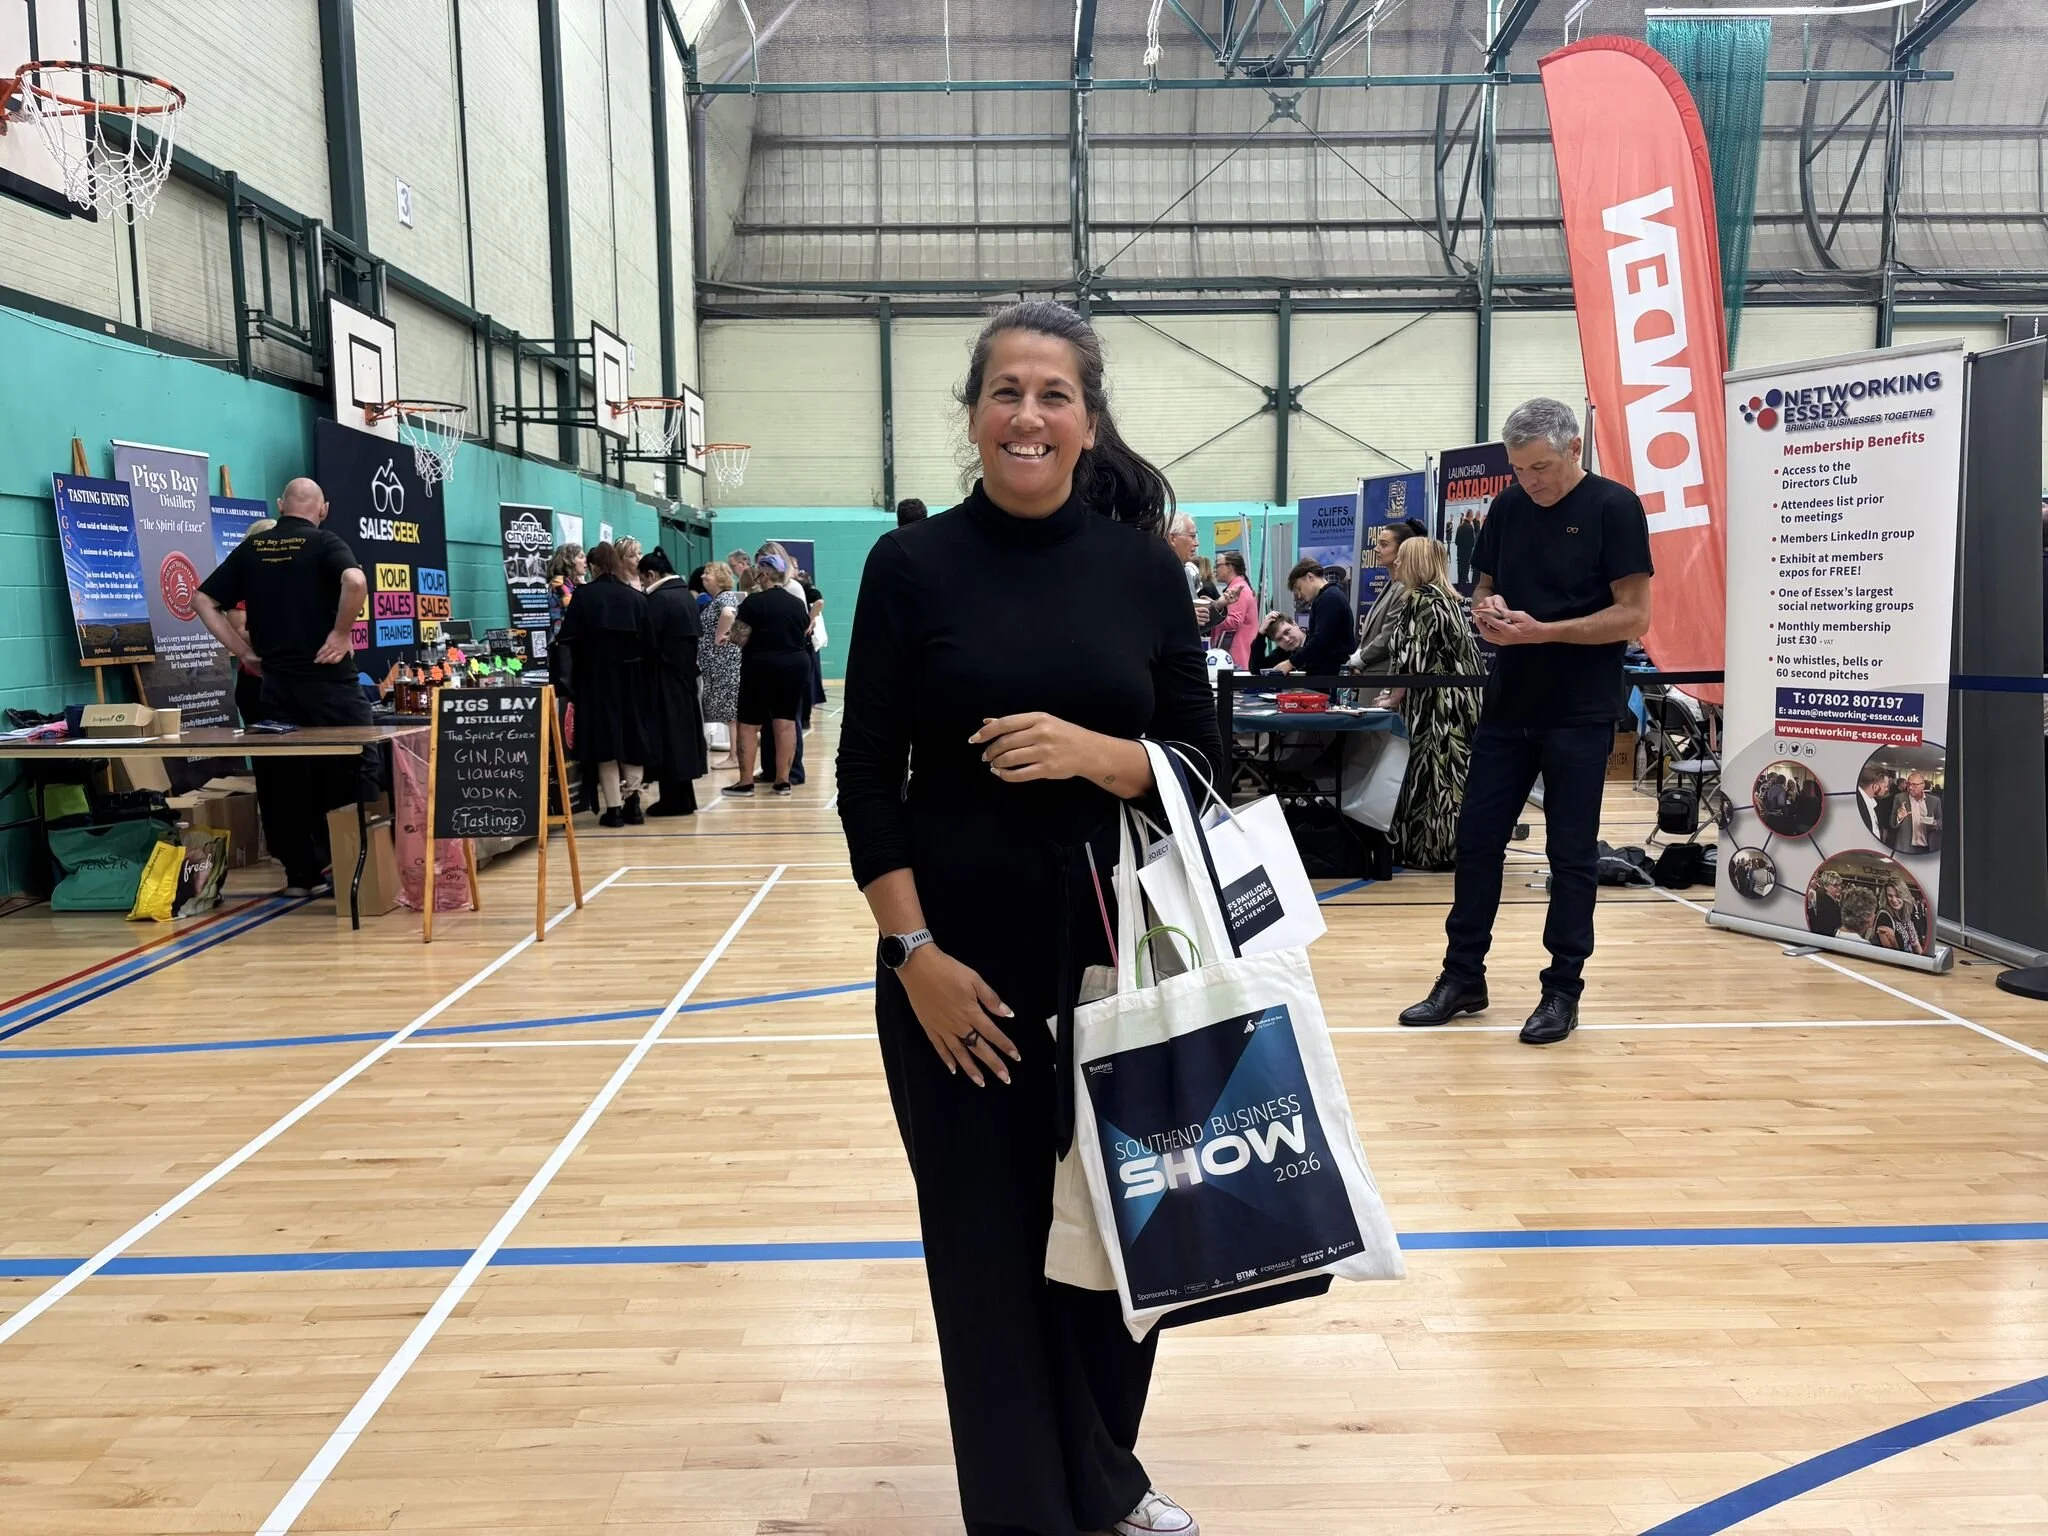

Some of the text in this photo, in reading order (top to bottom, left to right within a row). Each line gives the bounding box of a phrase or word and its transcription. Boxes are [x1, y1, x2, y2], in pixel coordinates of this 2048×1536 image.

[401, 188, 409, 217] 3
[1784, 371, 1941, 407] NETWORKING
[1784, 401, 1848, 424] ESSEX
[1785, 408, 1933, 432] BRINGING BUSINESSES TOGETHER
[1783, 432, 1925, 456] Membership Benefits
[1448, 464, 1486, 479] LAUNCHPAD
[1782, 461, 1851, 476] Access to the
[131, 464, 199, 497] Pigs Bay
[1782, 474, 1858, 490] Directors Club
[68, 488, 130, 507] TASTING EVENTS
[160, 494, 196, 512] Distillery
[1781, 494, 1885, 510] Attendees list prior
[1318, 506, 1349, 517] CLIFFS
[1781, 512, 1843, 524] to meetings
[156, 520, 176, 533] Spirit
[177, 520, 184, 534] of
[360, 516, 420, 544] SALESGEEK
[512, 522, 544, 533] DIGITAL
[1312, 516, 1354, 528] PAVILION
[506, 531, 552, 543] CITY RADIO
[1780, 529, 1915, 544] Members LinkedIn group
[1779, 551, 1884, 564] Exhibit at members
[380, 568, 407, 588] YOUR
[1779, 566, 1861, 579] expos for FREE!
[421, 572, 445, 592] YOUR
[1778, 586, 1893, 599] One of Essex's largest
[378, 595, 411, 617] SALES
[421, 597, 449, 618] SALES
[1778, 600, 1914, 613] social networking groups
[380, 625, 412, 641] TRAINER
[1777, 621, 1891, 634] Monthly membership
[1776, 635, 1796, 646] just
[1799, 635, 1817, 645] £30
[1777, 655, 1883, 667] No whistles, bells or
[1776, 669, 1869, 682] 60 second pitches
[443, 697, 537, 713] PIGS BAY
[1793, 692, 1903, 710] T: 07802 807197
[456, 714, 524, 725] DISTILLERY
[1779, 707, 1919, 724] E: aaron@networking-essex.co.uk
[444, 729, 536, 744] The Spirit of Essex
[1778, 725, 1918, 743] www.networking-essex.co.uk
[462, 787, 522, 799] VODKA.
[461, 813, 519, 831] Tastings
[184, 853, 213, 882] fresh
[1236, 881, 1267, 905] PAVILION
[1243, 887, 1273, 910] THEATRE
[1114, 1094, 1301, 1161] SOUTHEND BUSINESS
[1119, 1114, 1307, 1199] SHOW
[1273, 1152, 1321, 1183] 2026
[1338, 1241, 1355, 1251] AZETS
[1260, 1261, 1290, 1273] FORMARA
[1302, 1254, 1324, 1264] GRAY
[1236, 1268, 1258, 1281] BTMK
[1137, 1288, 1170, 1301] Sponsored
